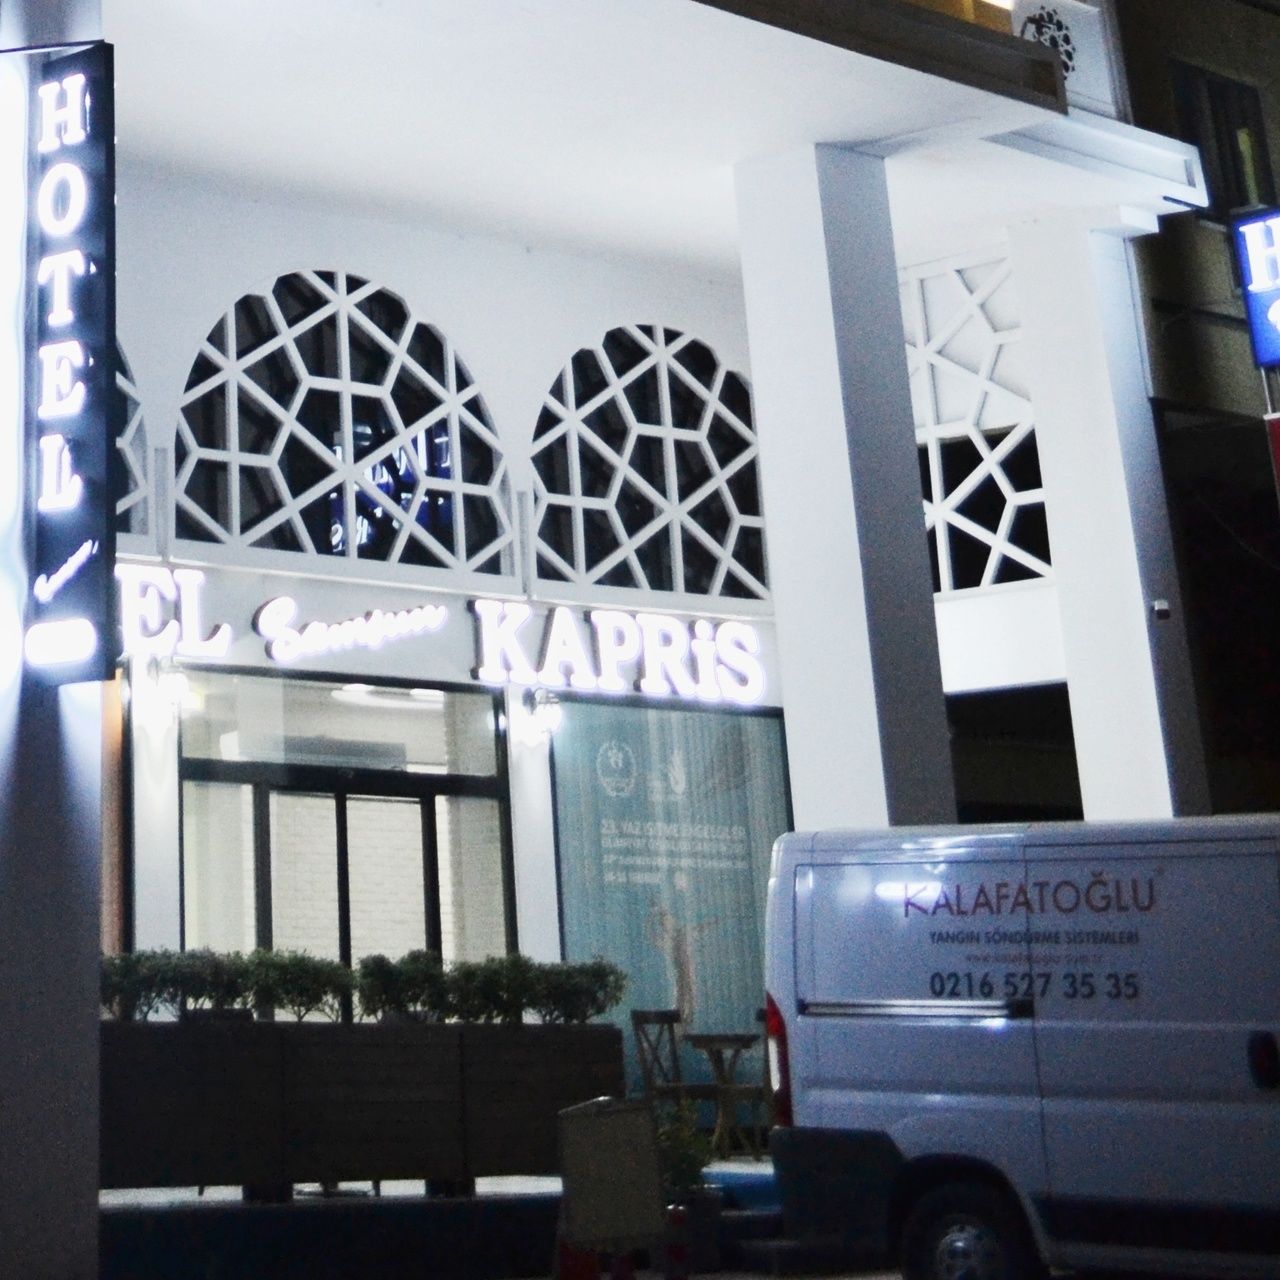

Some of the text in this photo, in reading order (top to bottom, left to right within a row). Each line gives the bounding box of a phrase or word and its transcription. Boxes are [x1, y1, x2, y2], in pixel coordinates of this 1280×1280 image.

[37, 72, 87, 512] HOTEL
[903, 869, 1156, 919] KALAFATOĞLU
[929, 971, 1139, 999] 0216 527 35 35
